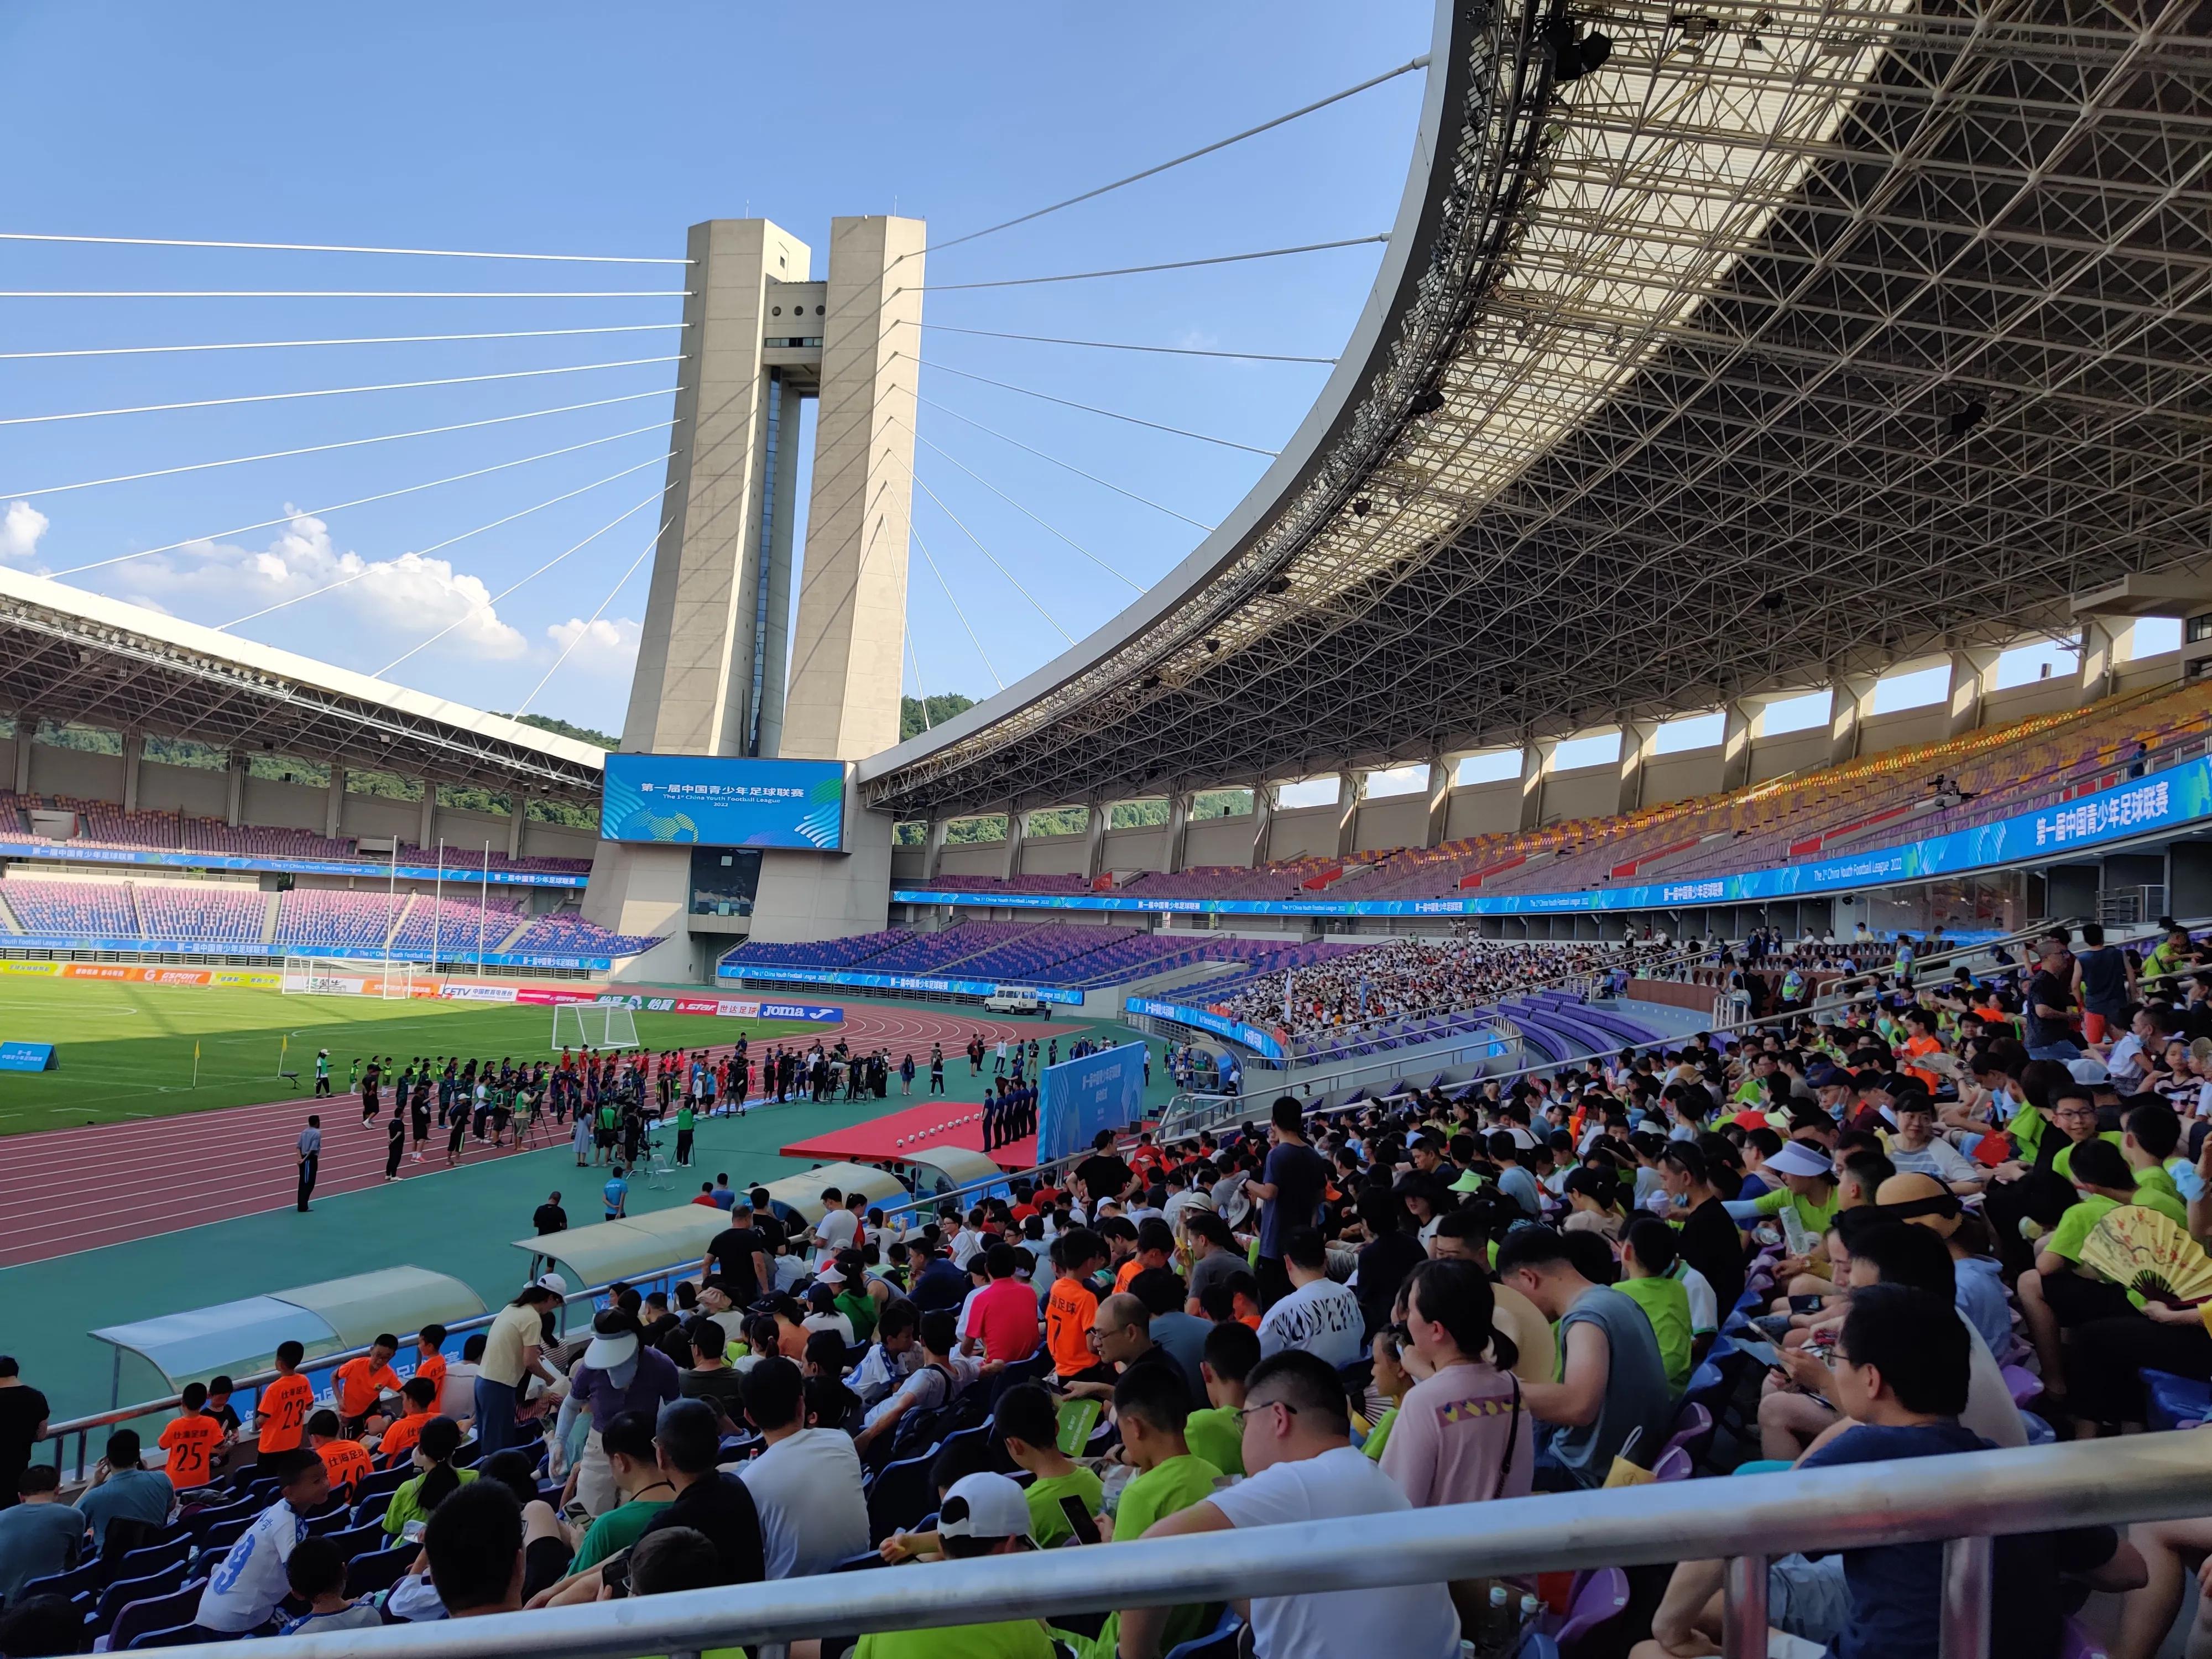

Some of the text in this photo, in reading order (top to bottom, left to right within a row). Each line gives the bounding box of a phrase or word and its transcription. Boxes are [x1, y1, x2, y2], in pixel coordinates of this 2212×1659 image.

[641, 783, 804, 797] 第一届中国青少年足球联赛
[2037, 781, 2169, 846] 第一届中国青少年足球联赛
[32, 847, 135, 860] 第一届中国青少年足球联赛
[1828, 868, 1839, 880] China
[1840, 864, 1853, 878] Youth
[1872, 860, 1889, 875] League
[1891, 858, 1902, 871] 2022
[177, 943, 268, 954] 第一届中国青少年足球联赛
[720, 1005, 757, 1014] 世达足球
[1051, 1314, 1062, 1355] 7
[281, 1399, 304, 1430] 23
[176, 1442, 203, 1472] 25
